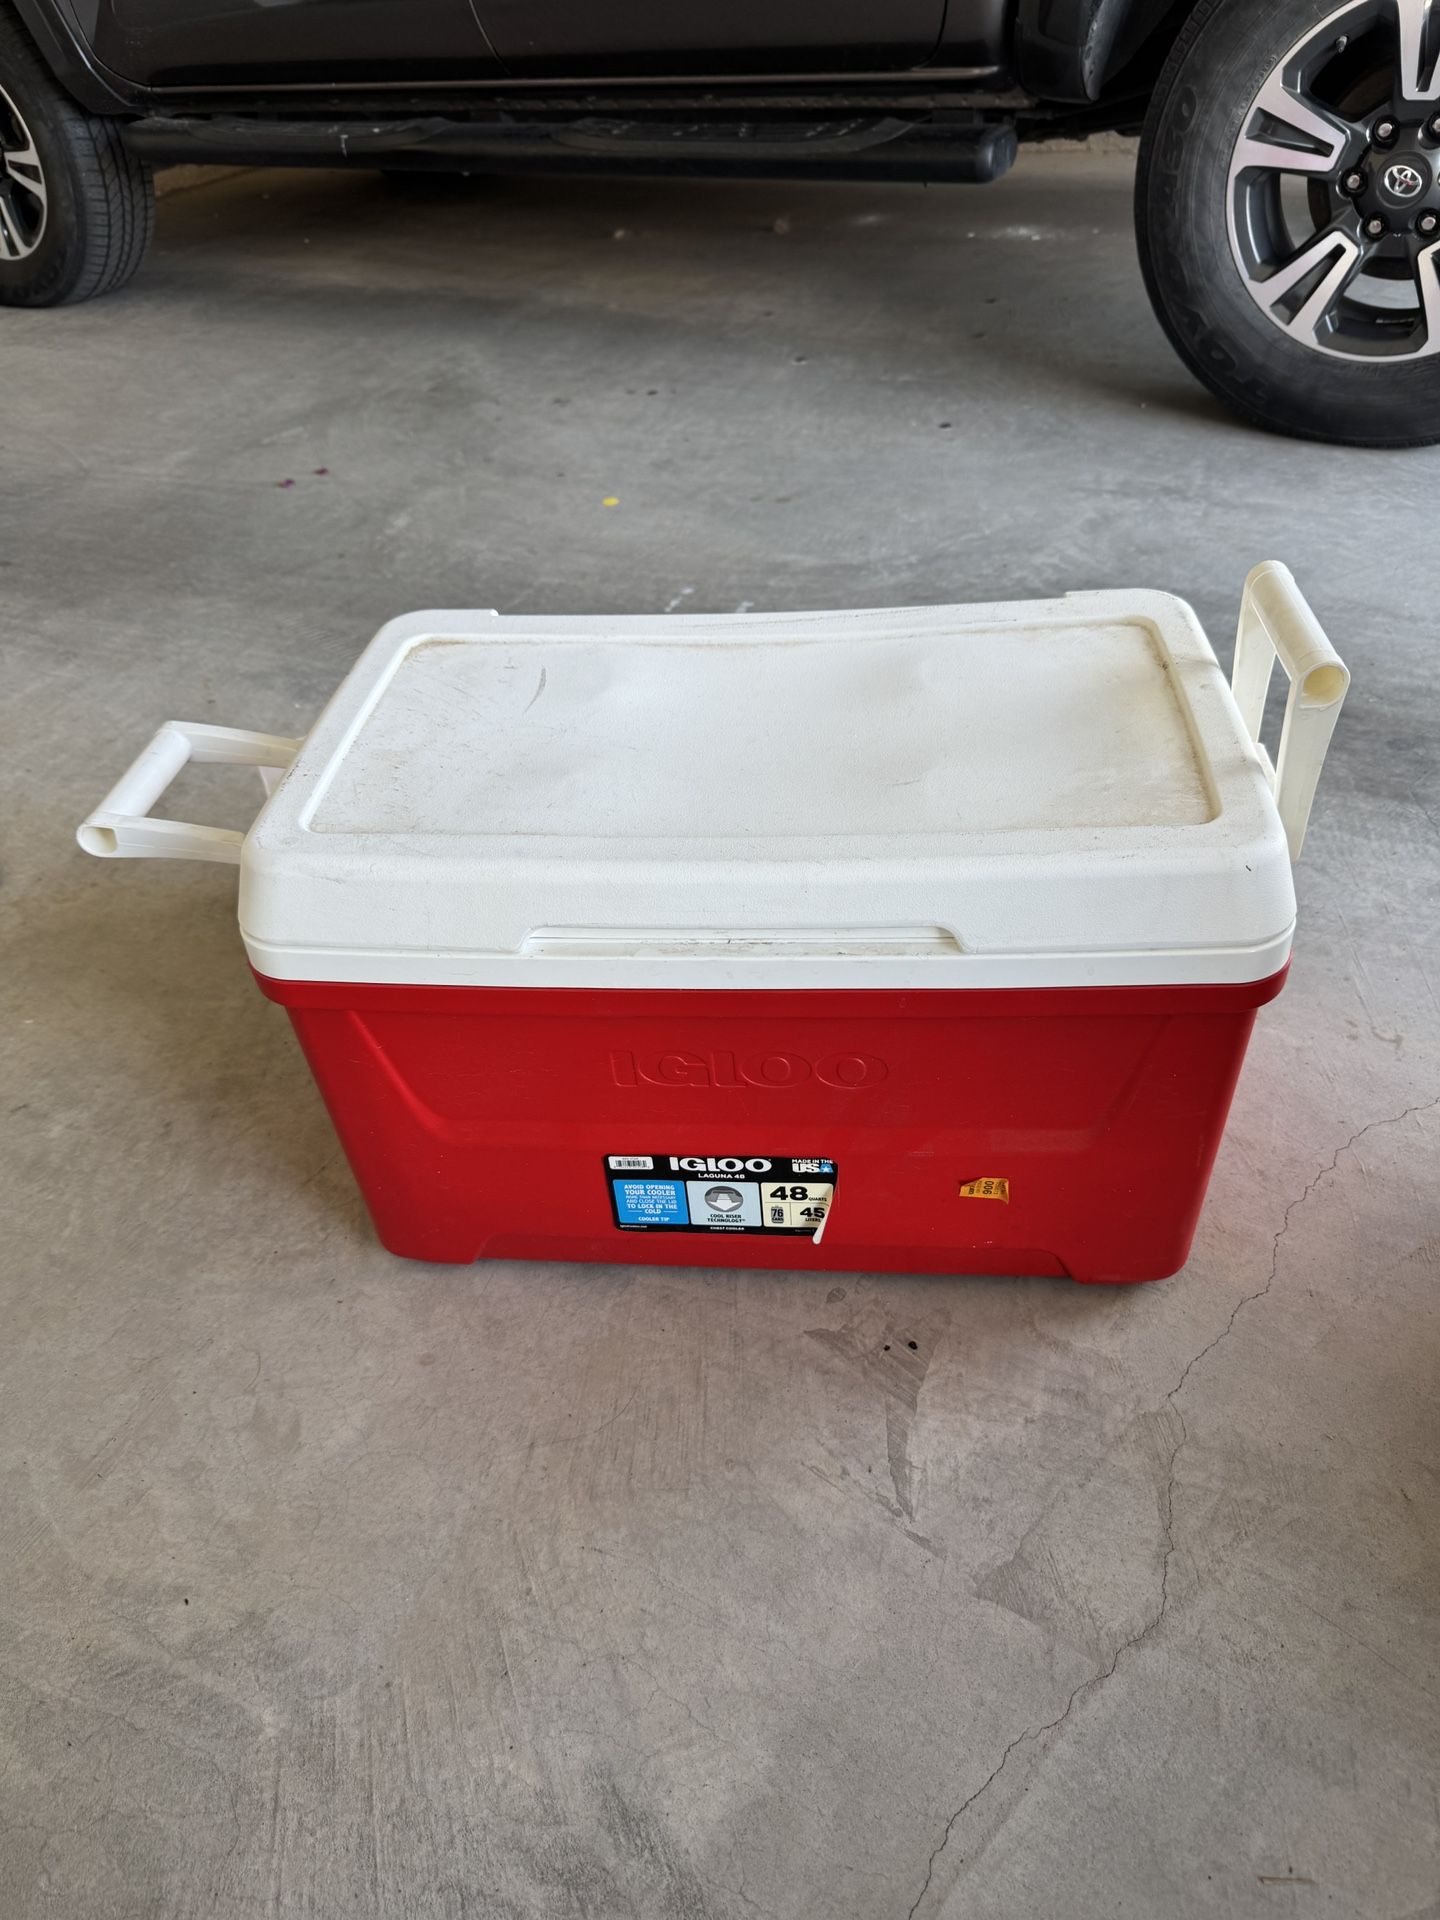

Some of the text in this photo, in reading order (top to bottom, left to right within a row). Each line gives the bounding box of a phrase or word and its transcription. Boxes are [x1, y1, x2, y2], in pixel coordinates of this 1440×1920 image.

[1155, 250, 1273, 402] TOYO
[610, 1050, 889, 1089] IGLOO
[669, 1156, 772, 1172] IGLOO
[792, 1163, 834, 1173] USA
[770, 1186, 809, 1201] 48
[982, 1180, 995, 1195] 900
[771, 1208, 784, 1218] 76
[800, 1207, 826, 1219] 45
